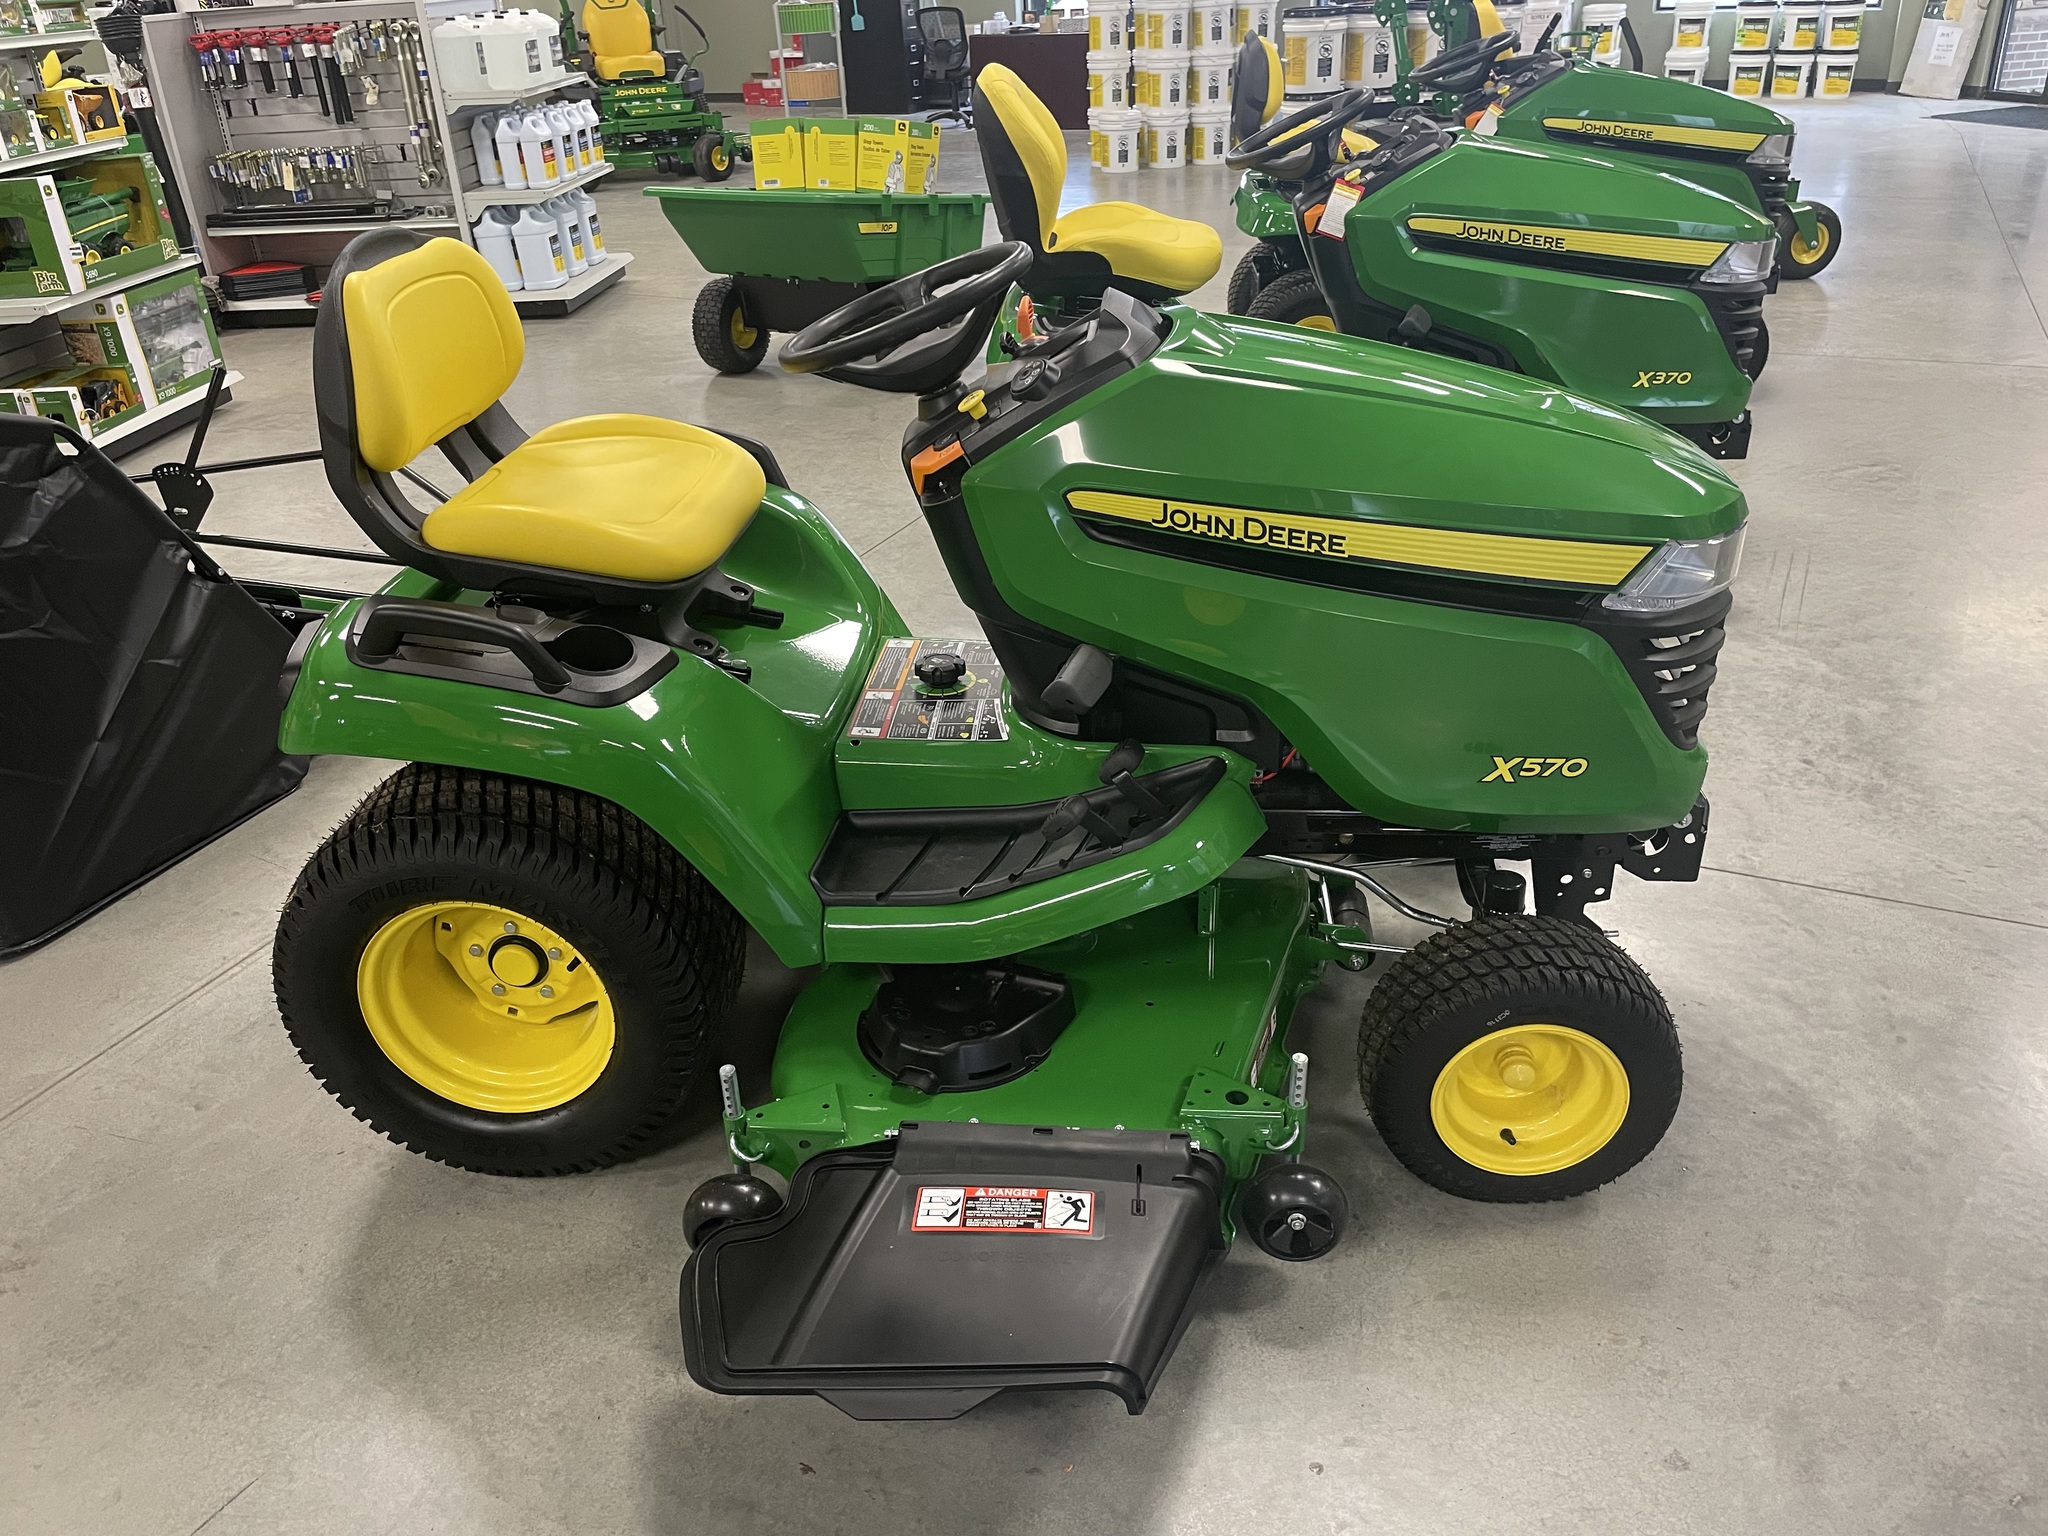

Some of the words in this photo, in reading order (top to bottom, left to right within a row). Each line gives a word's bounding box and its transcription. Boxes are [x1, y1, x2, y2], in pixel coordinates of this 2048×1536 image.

[614, 89, 638, 97] JOHN
[638, 86, 668, 95] DEERE
[1577, 121, 1611, 134] JOHN
[1613, 125, 1654, 139] DEERE
[1456, 222, 1504, 242] JOHN
[1508, 228, 1566, 250] DEERE
[35, 271, 56, 284] Big
[38, 280, 63, 292] farm
[102, 326, 111, 337] X9
[107, 338, 118, 357] 1000
[1631, 371, 1692, 388] X370
[157, 391, 165, 400] X9
[165, 387, 176, 397] 1000
[1151, 502, 1236, 538] JOHN
[1243, 516, 1347, 555] DEERE
[1478, 756, 1589, 782] X570
[988, 1188, 1038, 1197] DANGER
